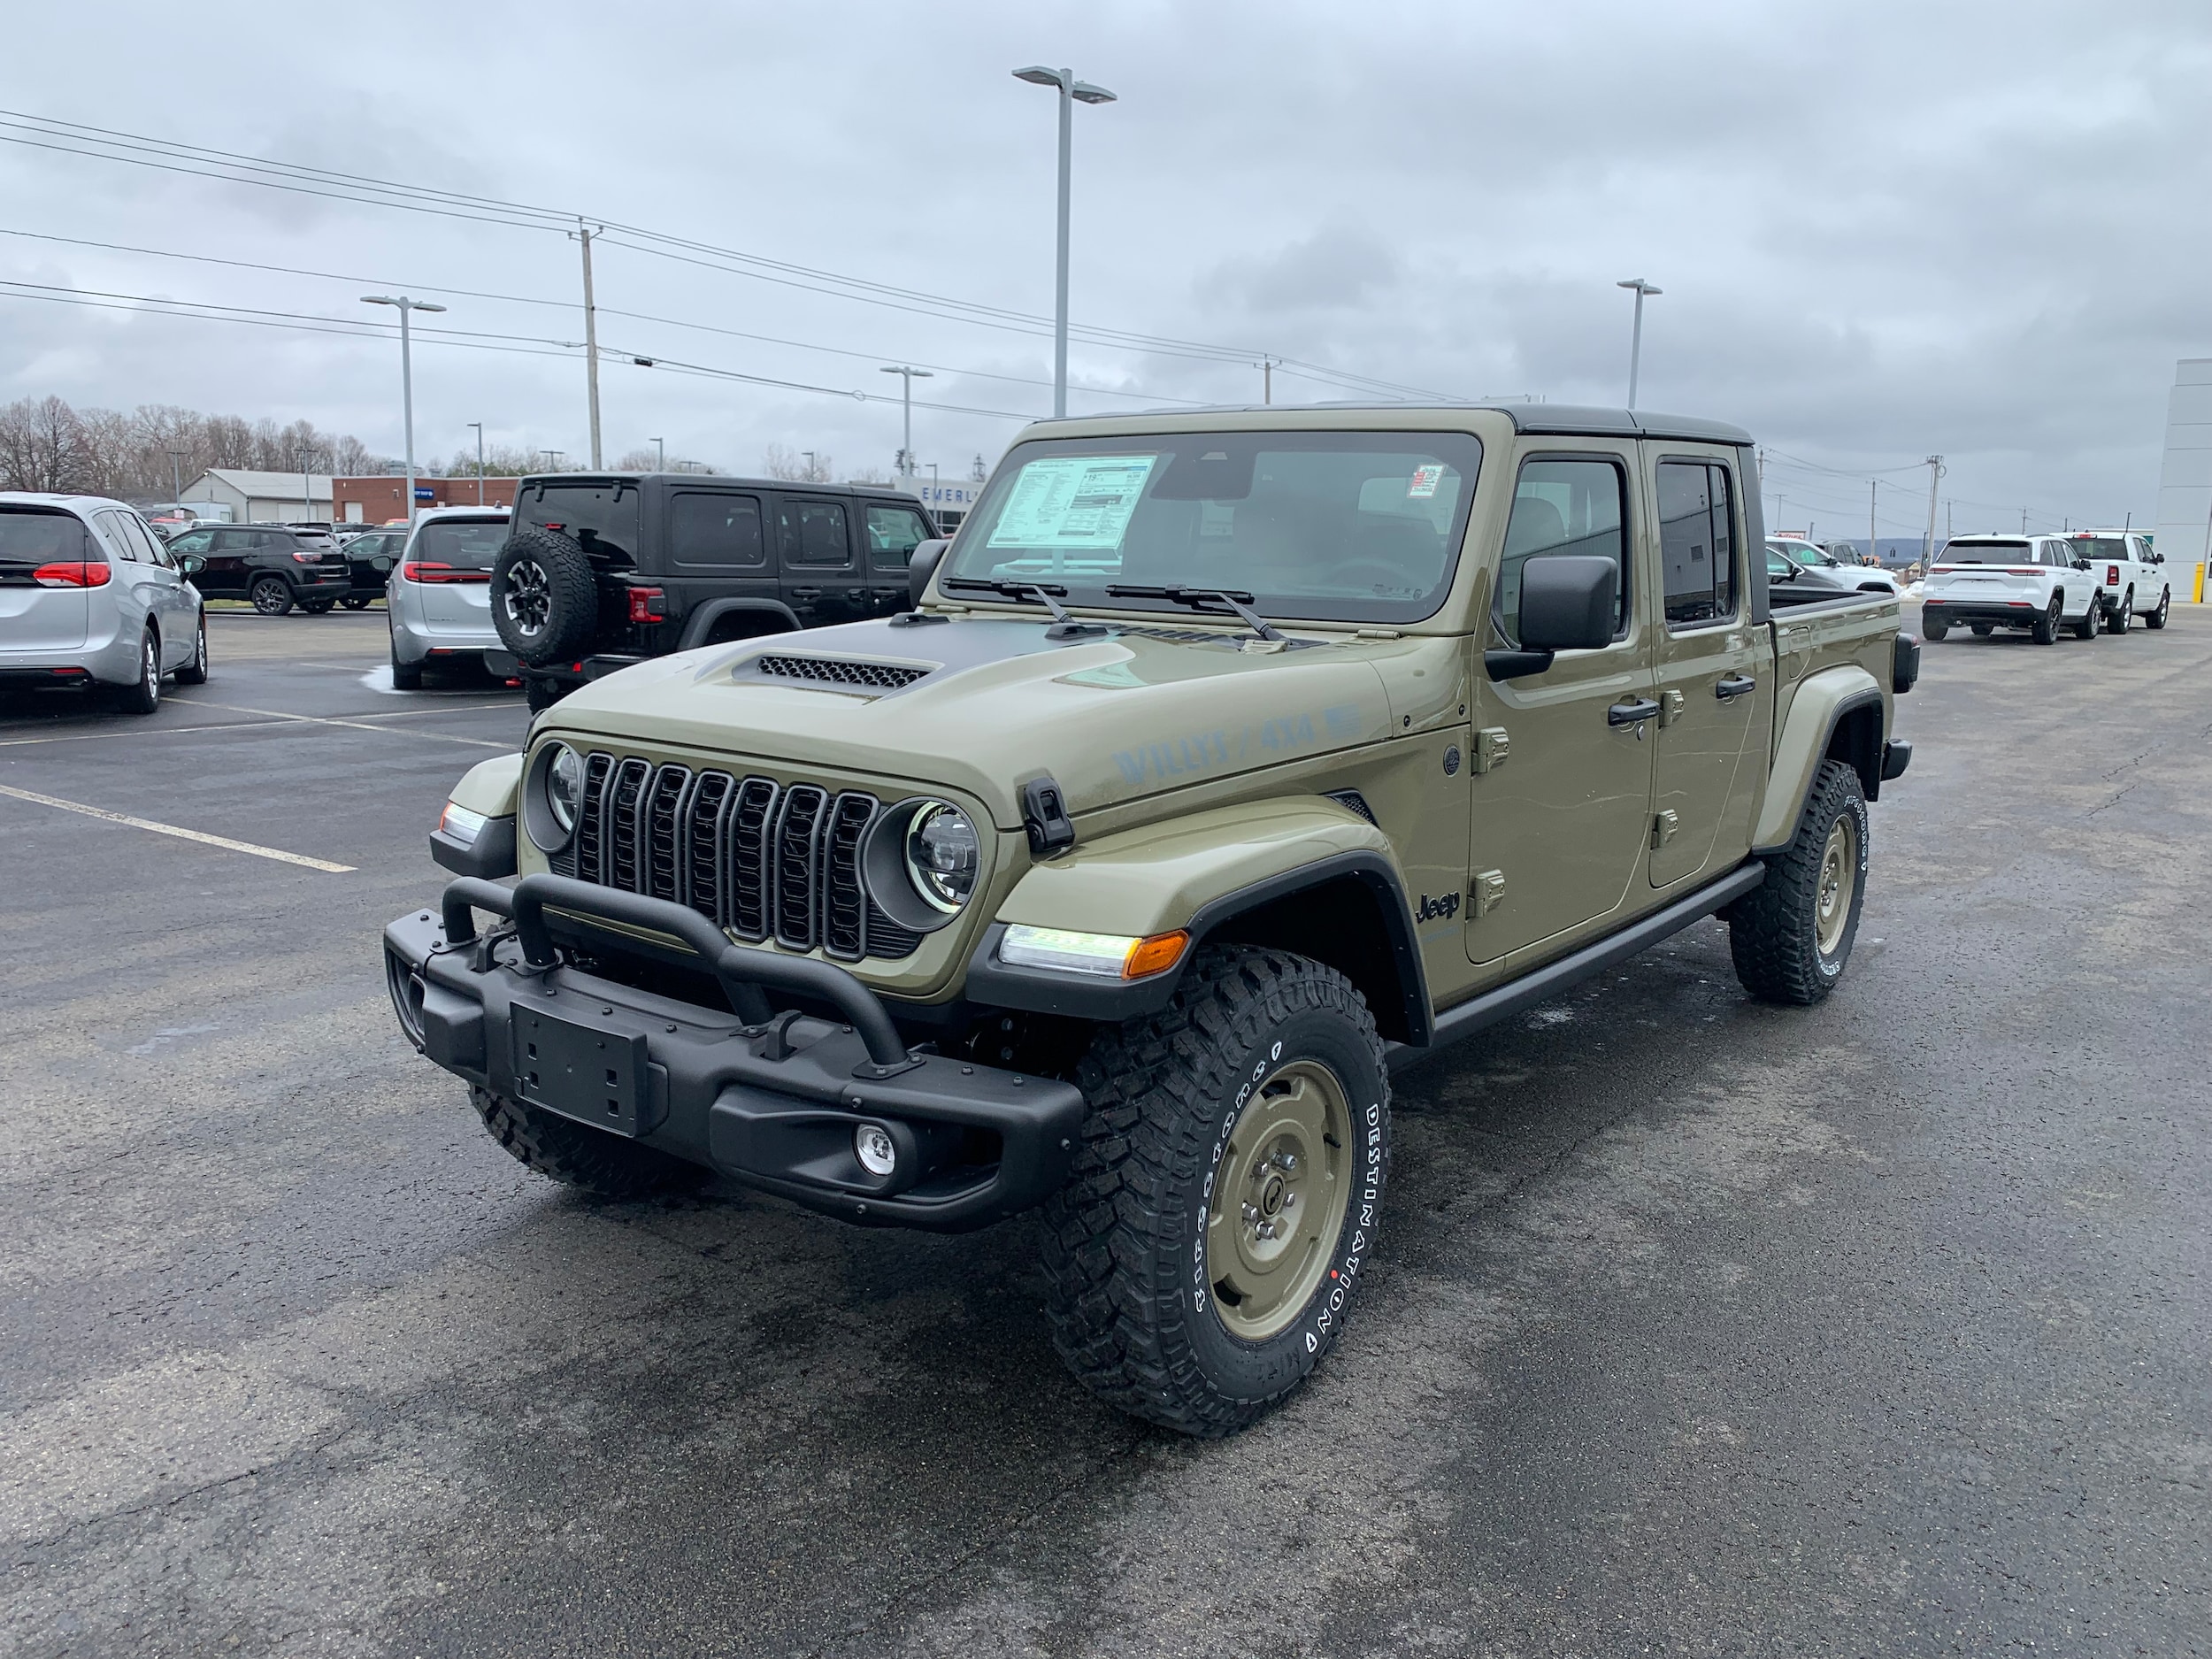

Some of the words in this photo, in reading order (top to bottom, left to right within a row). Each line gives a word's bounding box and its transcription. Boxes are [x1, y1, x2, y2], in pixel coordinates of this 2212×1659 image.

[1111, 729, 1229, 785] WILLYS
[1415, 890, 1460, 925] Jeep
[1317, 1102, 1380, 1335] DESTINATION
